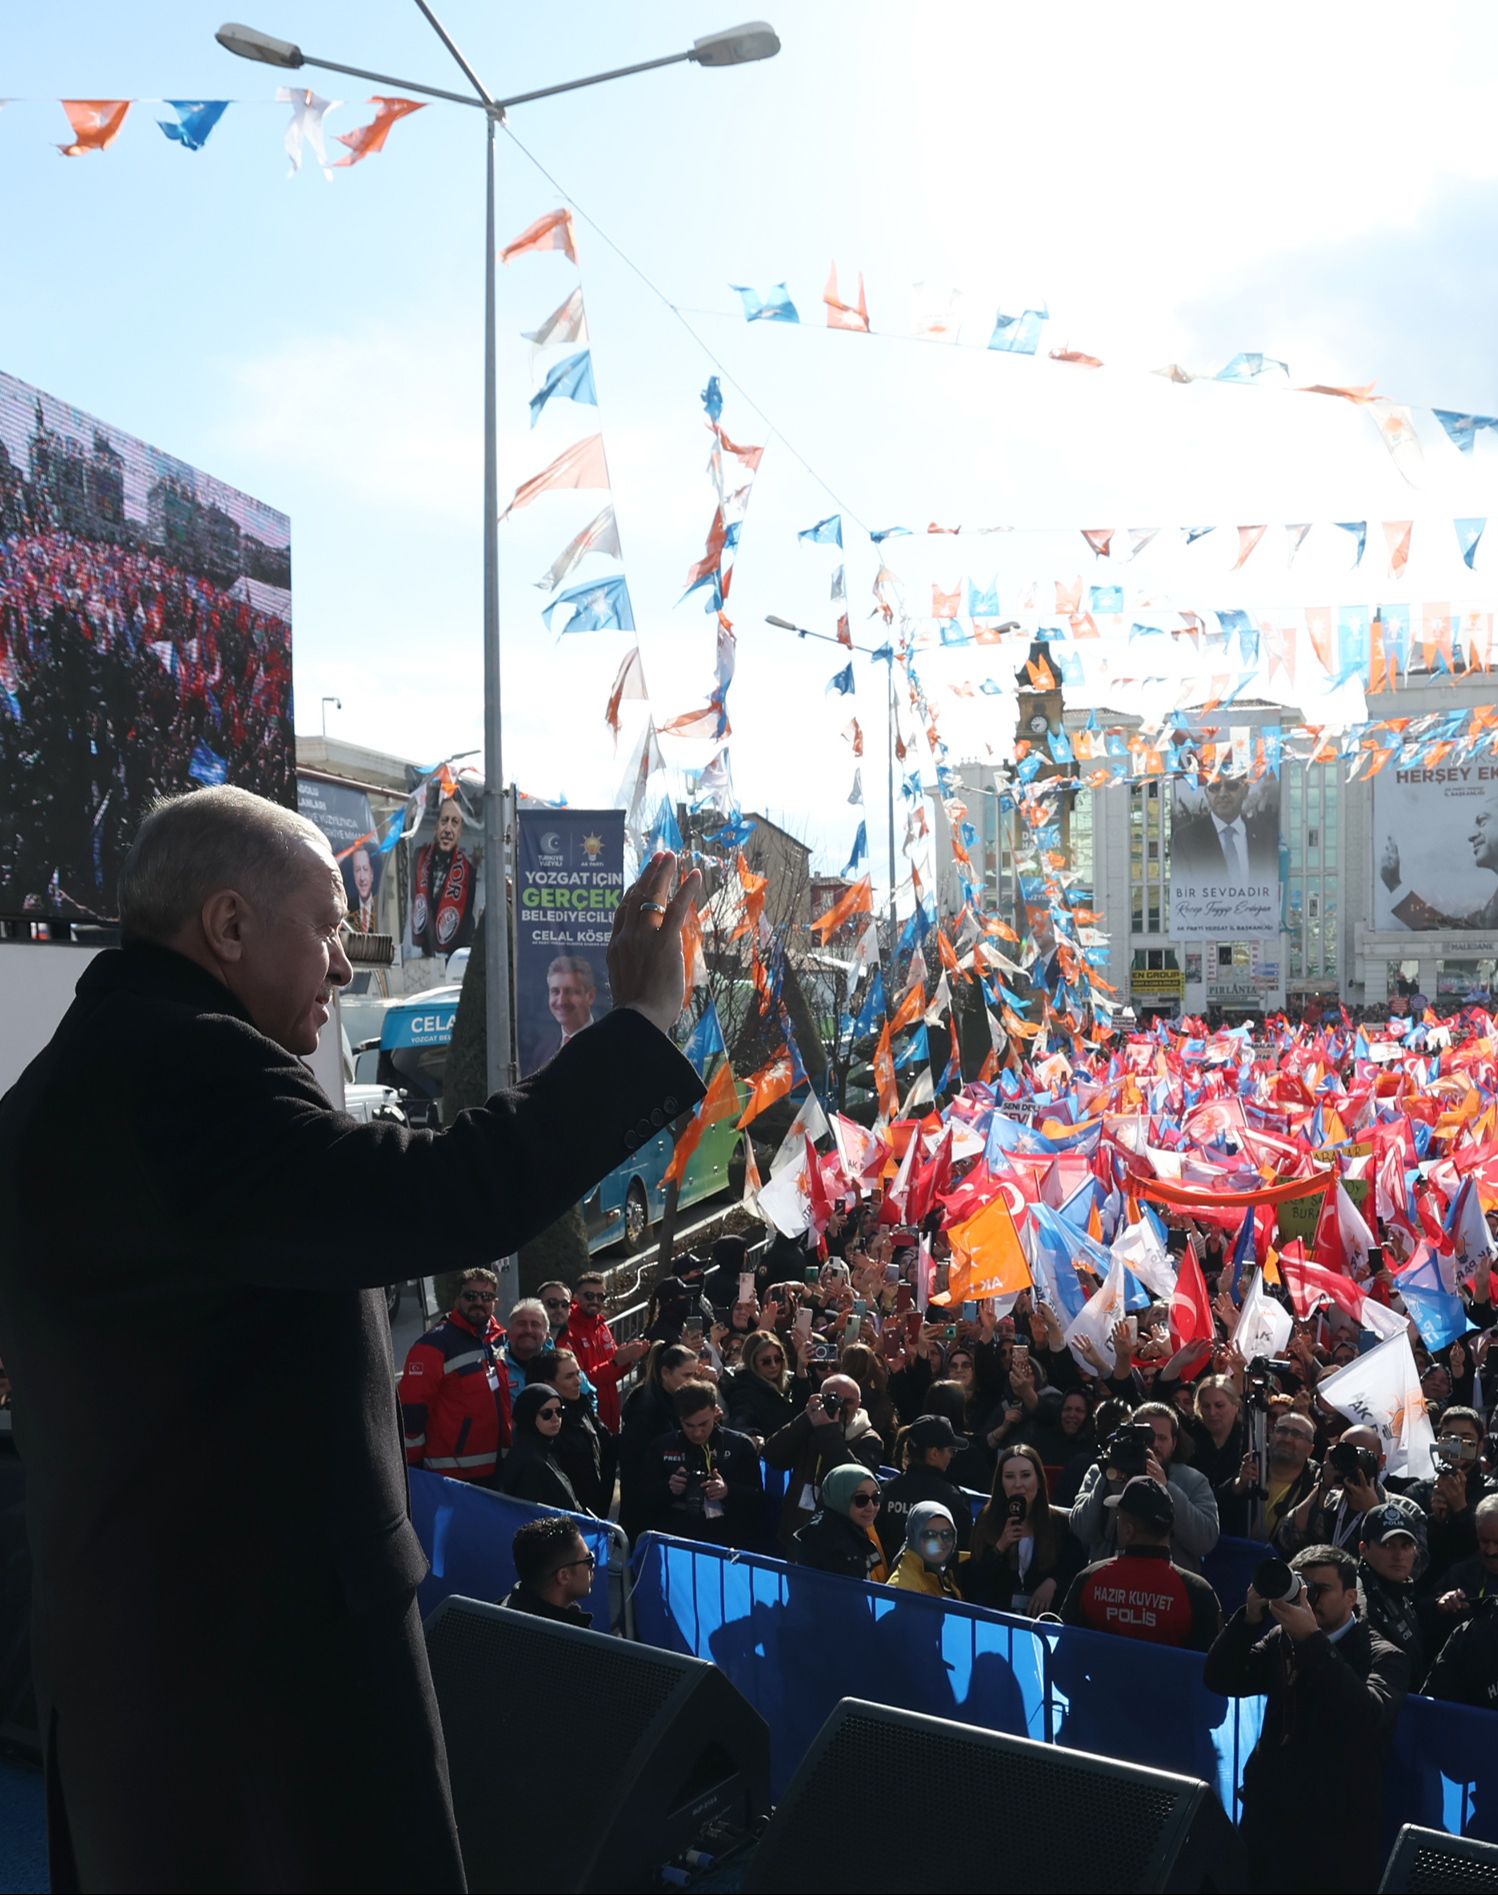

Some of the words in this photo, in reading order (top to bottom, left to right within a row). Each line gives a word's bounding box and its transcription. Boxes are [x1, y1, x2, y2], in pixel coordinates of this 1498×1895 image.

[1396, 768, 1471, 784] HERŞEY
[525, 871, 590, 885] YOZGAT
[592, 872, 623, 888] İÇİN
[522, 887, 621, 910] GERÇEK
[1176, 885, 1196, 898] BİR
[1202, 887, 1270, 898] SEVDADIR
[522, 910, 616, 923] BELEDİYECİLİ
[532, 930, 573, 942] CELAL
[577, 929, 612, 943] KÖSE
[1094, 1586, 1126, 1604] HAZIR
[1128, 1590, 1174, 1611] KUVVET
[1106, 1607, 1156, 1627] POLİS
